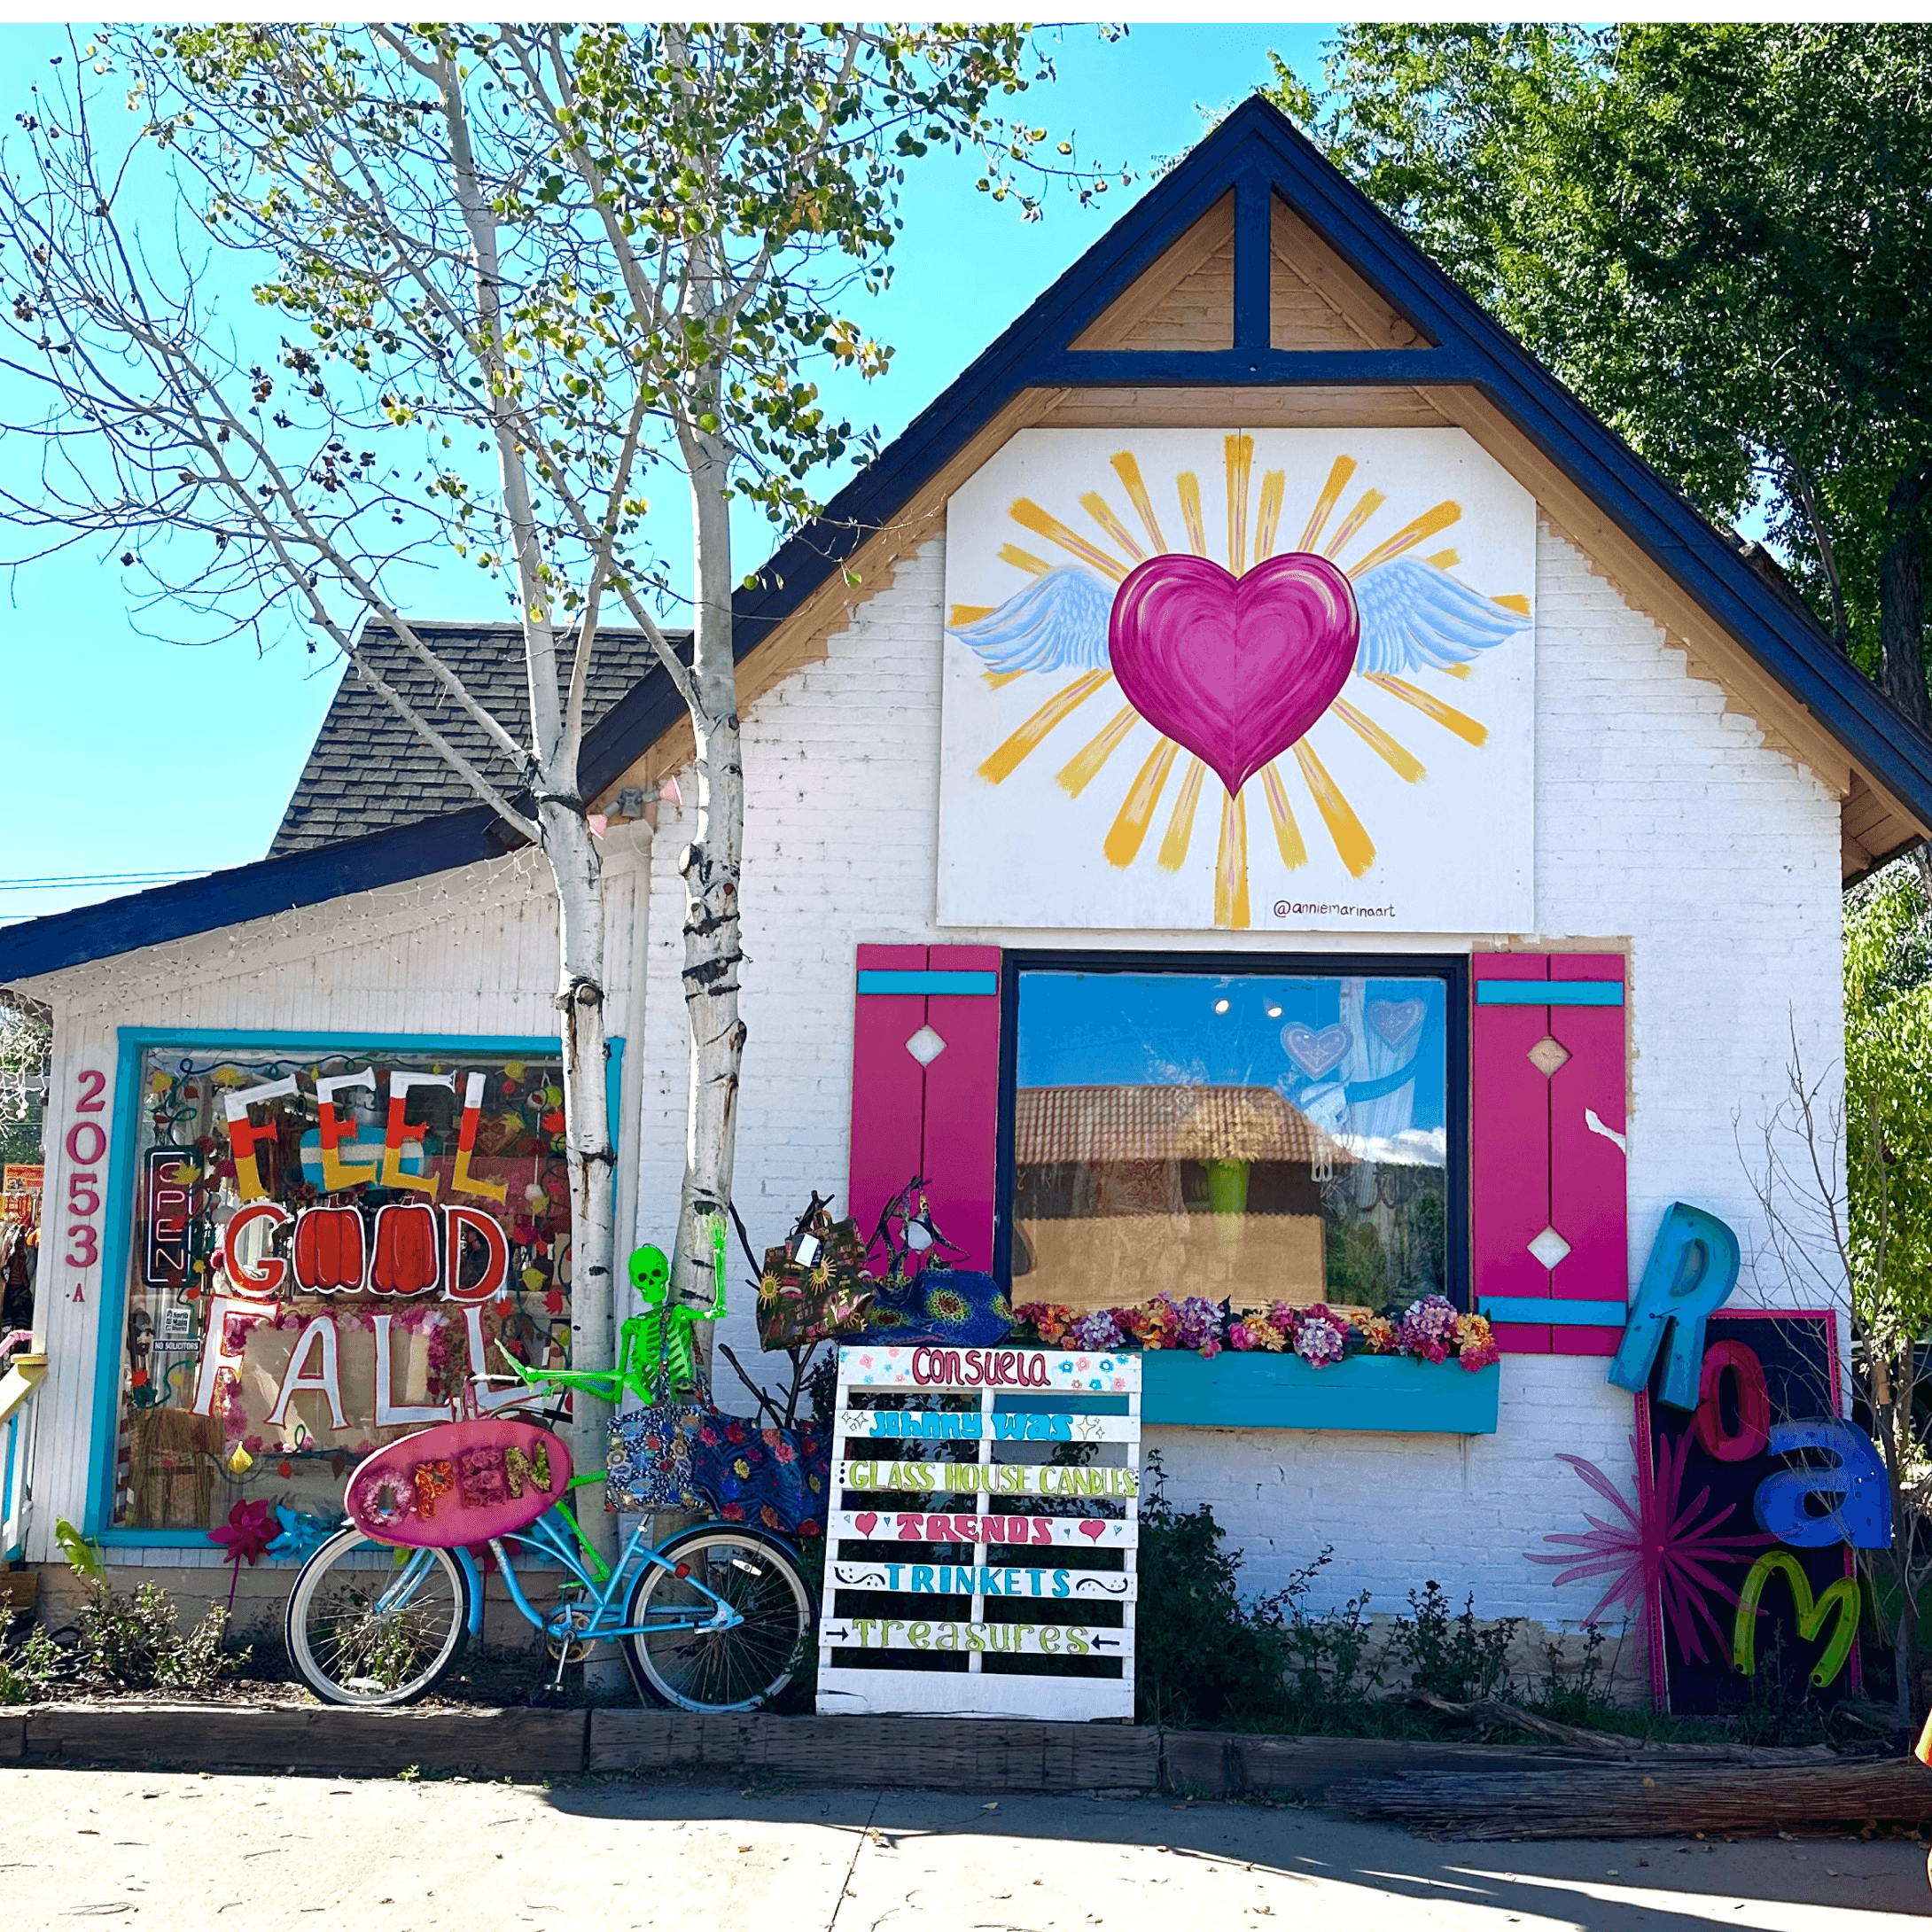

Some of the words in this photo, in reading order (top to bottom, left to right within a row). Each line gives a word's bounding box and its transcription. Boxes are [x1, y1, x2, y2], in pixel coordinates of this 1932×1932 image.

[1274, 900, 1396, 918] @anniemarinaart
[223, 1066, 510, 1205] FEEL
[65, 1070, 107, 1268] 2053
[154, 1341, 164, 1351] NO
[165, 1341, 199, 1351] SOLICITORS
[191, 1295, 551, 1430] FALL
[912, 1346, 1051, 1386] Consuela
[357, 1440, 554, 1528] OPEN
[849, 1461, 936, 1492] GLASS
[944, 1462, 1033, 1493] HOUSE
[1039, 1466, 1140, 1498] CANDLES
[896, 1513, 1054, 1545] TRENDS
[884, 1564, 1071, 1598] TRINKETS
[852, 1618, 1090, 1655] Treasures
